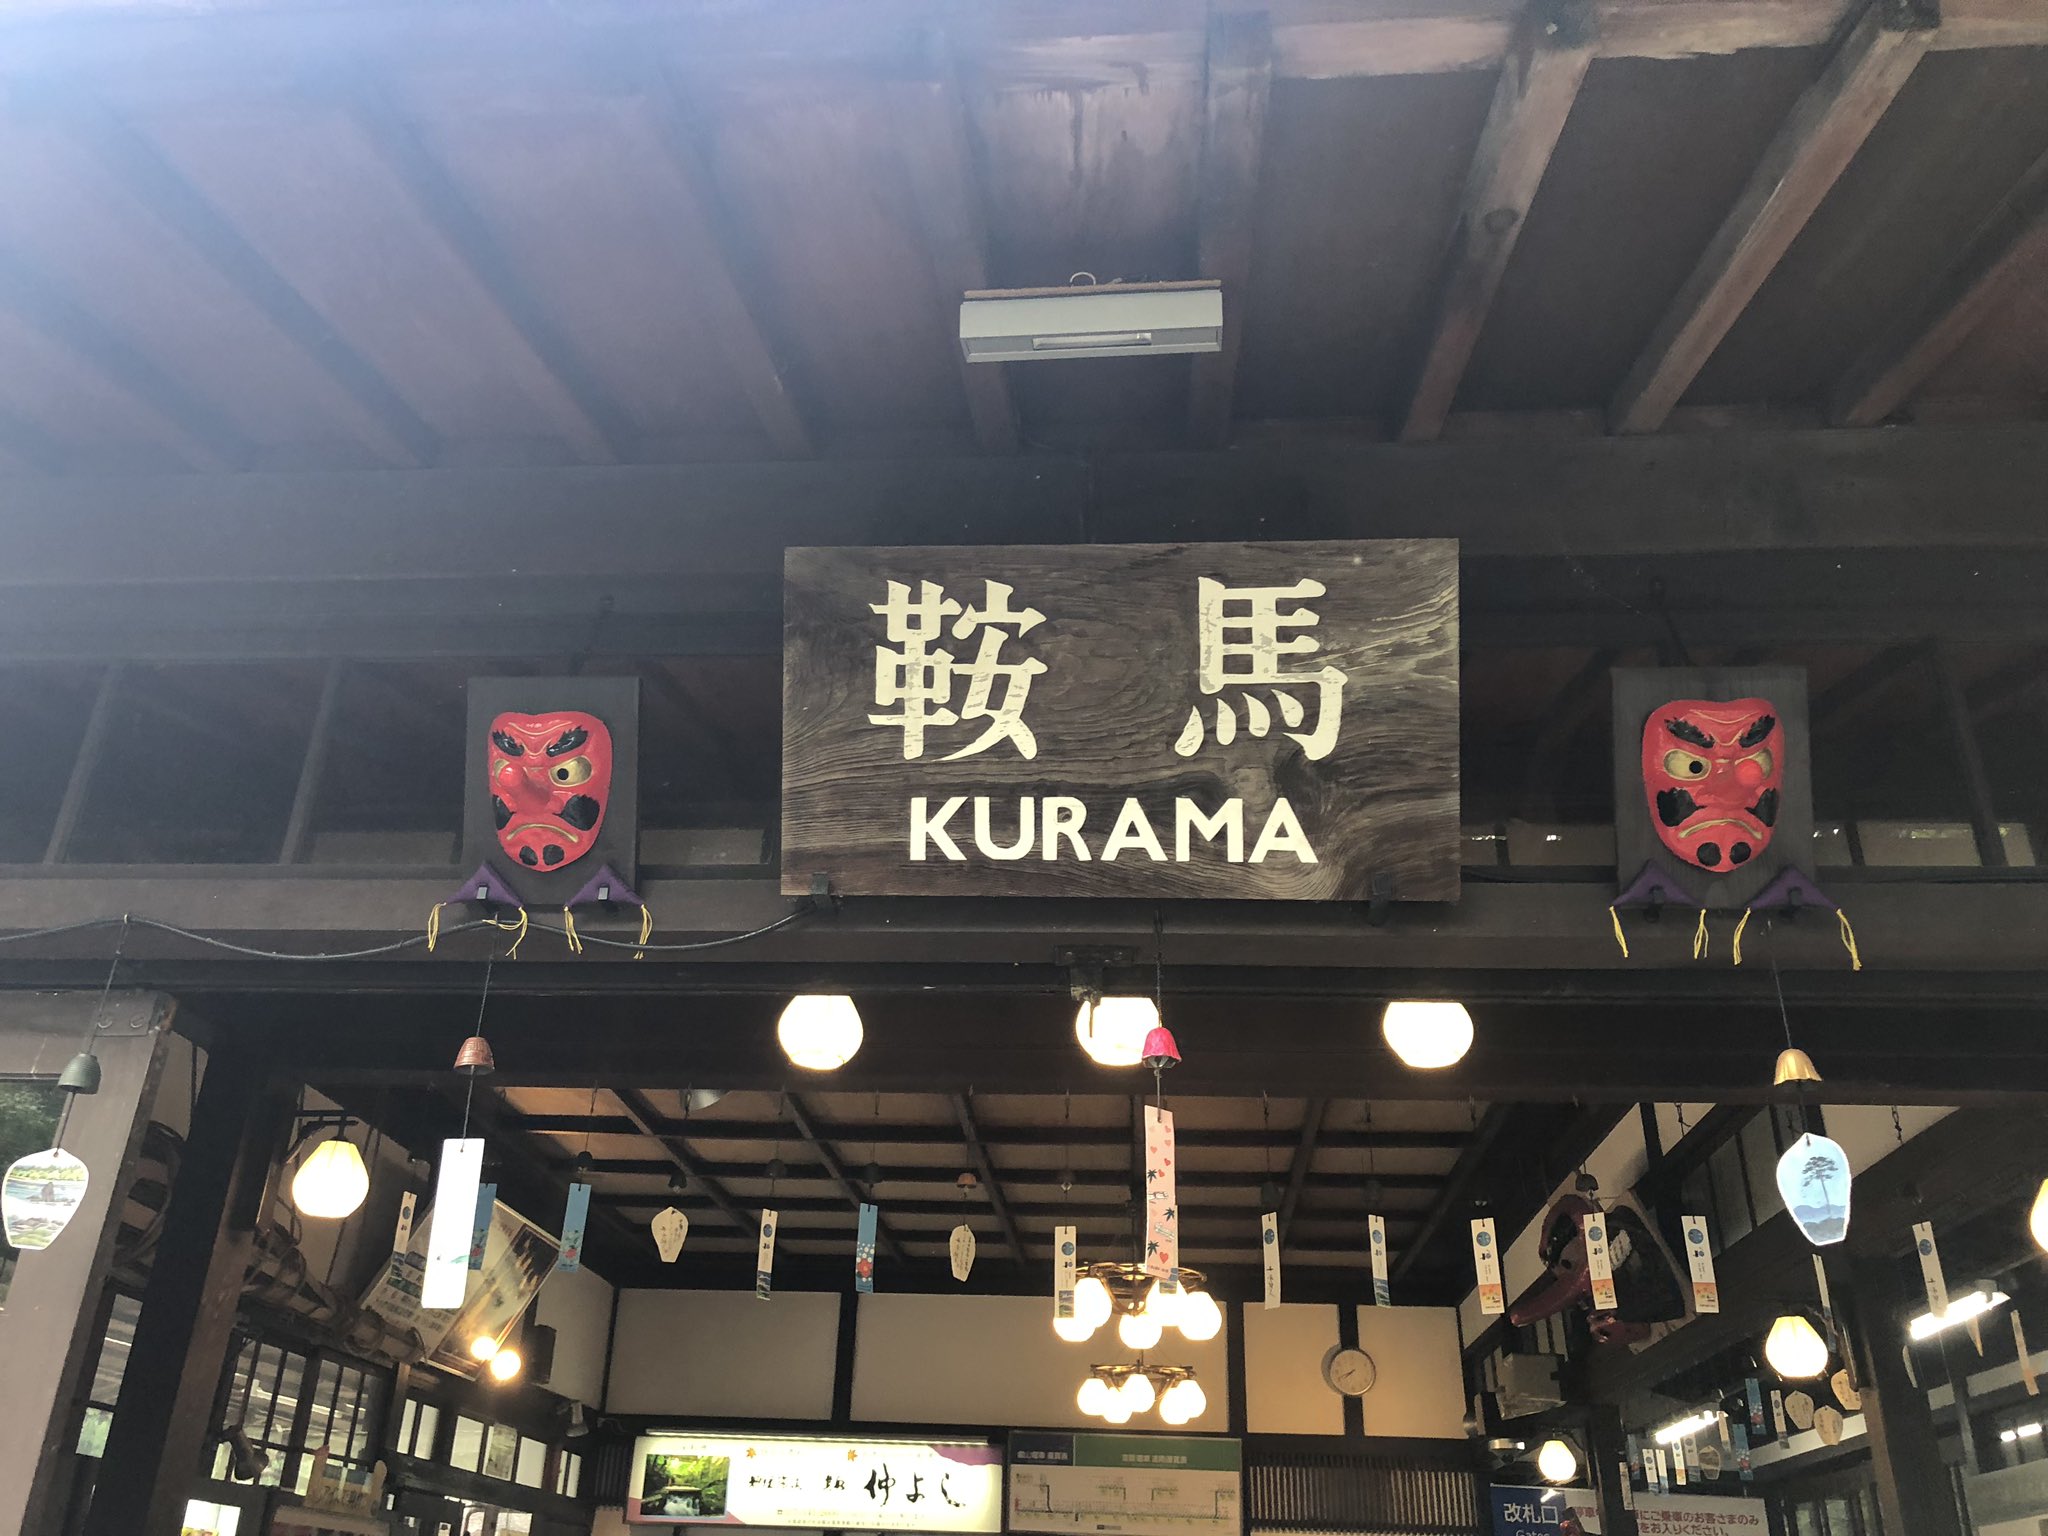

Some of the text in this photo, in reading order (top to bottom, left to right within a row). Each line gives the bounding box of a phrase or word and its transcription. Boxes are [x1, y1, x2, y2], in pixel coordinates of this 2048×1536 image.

[867, 577, 1348, 761] 鞍馬
[909, 796, 1319, 863] KURAMA
[863, 1462, 966, 1508] 仲よし
[1503, 1502, 1559, 1524] 改札口
